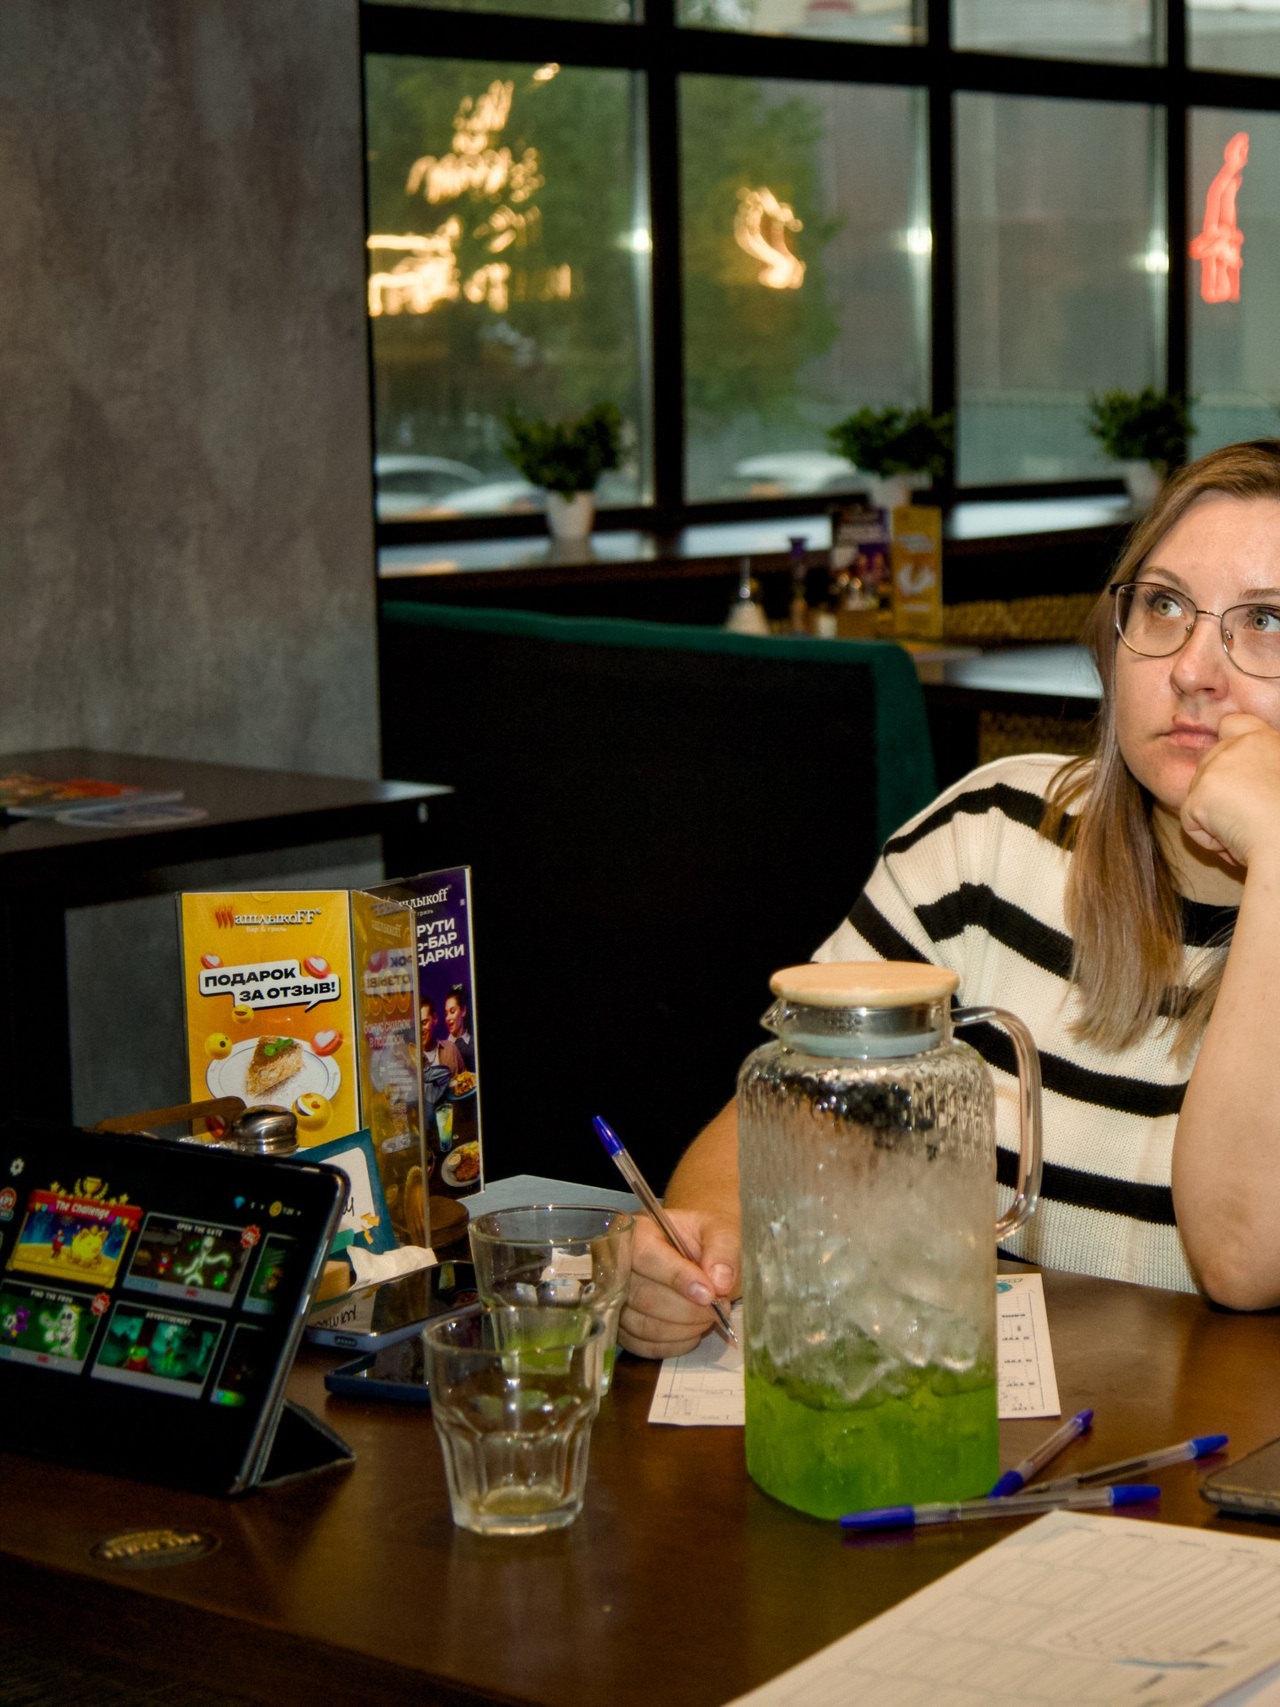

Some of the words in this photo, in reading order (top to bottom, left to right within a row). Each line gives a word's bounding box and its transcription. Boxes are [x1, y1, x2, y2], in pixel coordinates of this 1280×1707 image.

[417, 918, 455, 938] РУТИ
[204, 967, 296, 988] ПОДАРОК
[239, 989, 264, 1002] ЗА
[266, 982, 336, 999] ОТЗЫВ!
[56, 1200, 70, 1211] The
[71, 1204, 110, 1220] Challenge
